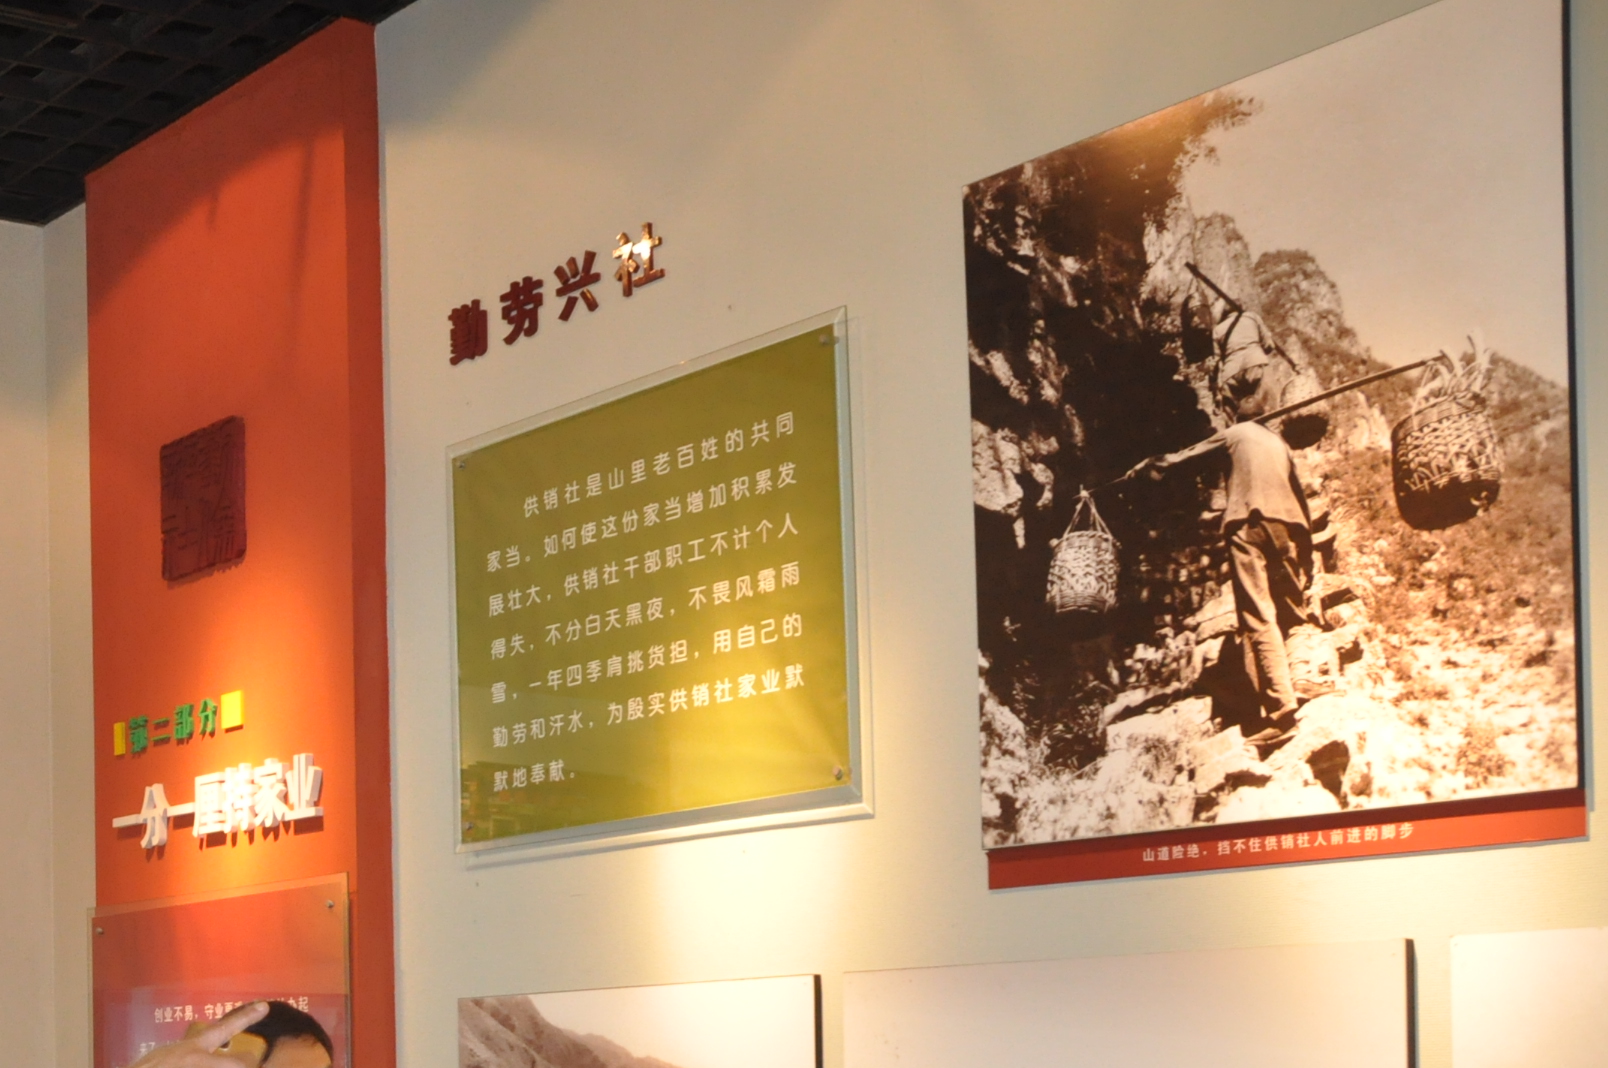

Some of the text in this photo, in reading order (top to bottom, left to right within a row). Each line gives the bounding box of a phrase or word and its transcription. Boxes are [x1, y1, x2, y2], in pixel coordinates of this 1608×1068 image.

[448, 221, 666, 367] 勤劳兴社
[523, 411, 794, 518] 供销社是山里老百姓的共同
[486, 462, 797, 573] 家当。如何使这份家当增加积累发
[488, 512, 799, 618] 展壮大，供销社干部职工不计个人
[491, 561, 800, 660] 得失，不分白天黑夜，不畏风霜雨
[491, 612, 803, 704] 雪，一年四季肩挑货担，用自己的
[128, 697, 218, 754] 第二部分
[492, 663, 805, 749] 勤劳和汗水，为殷实供销社家业默
[493, 759, 576, 793] 默地奉献。
